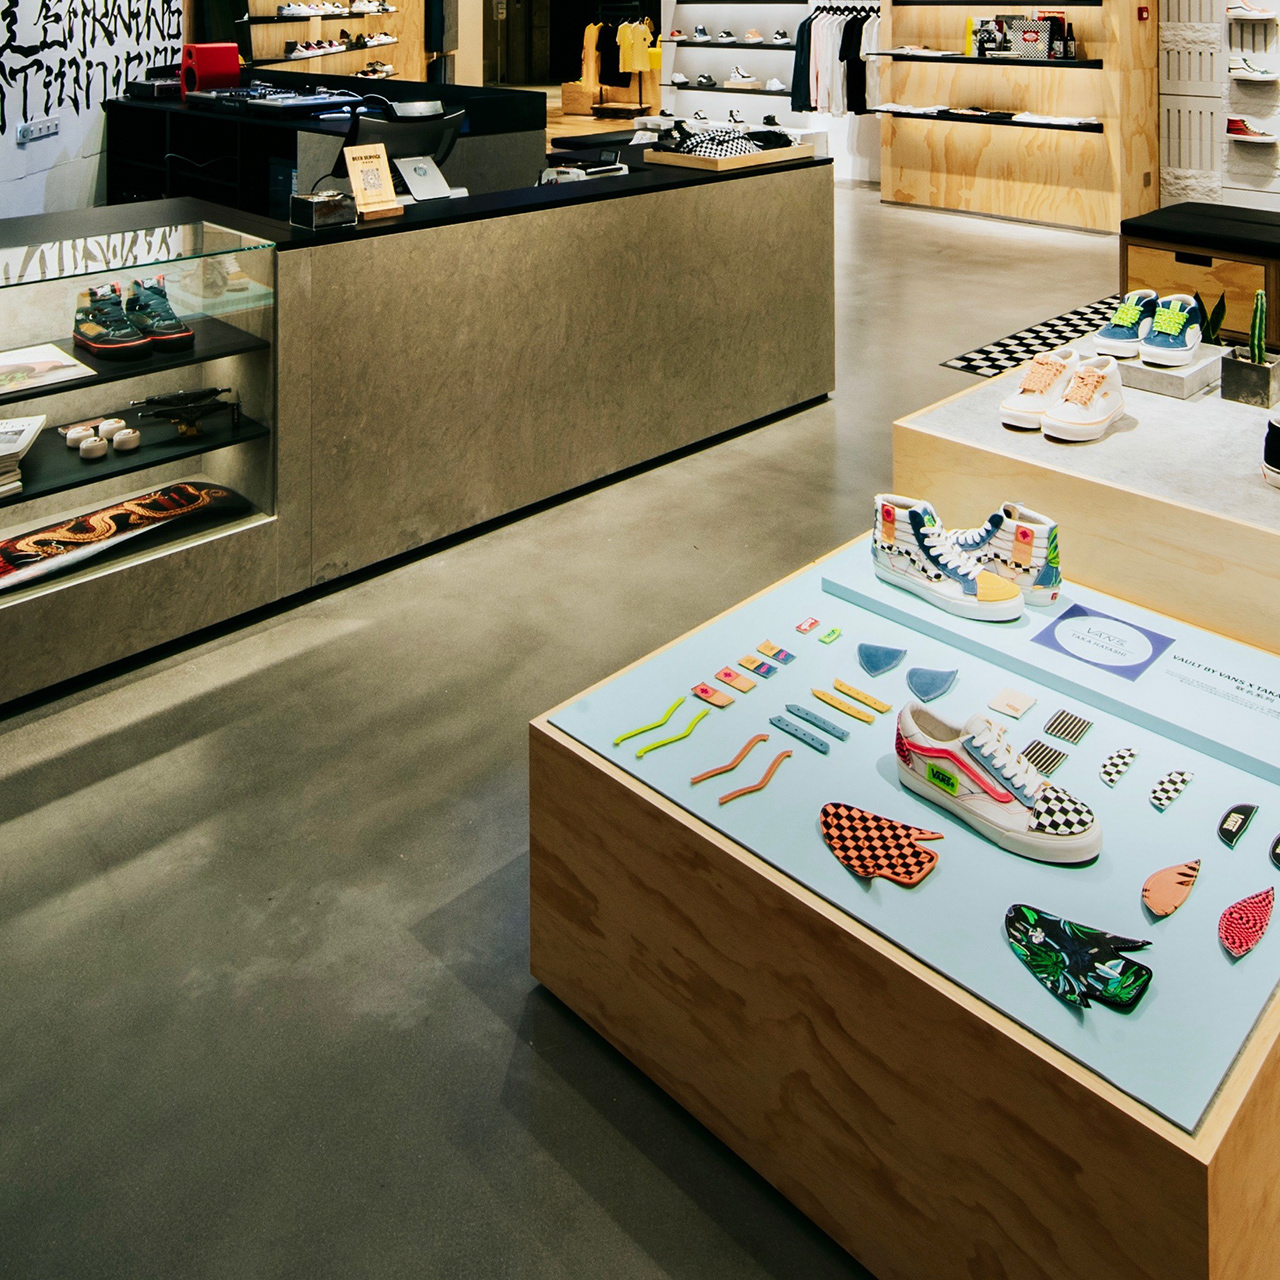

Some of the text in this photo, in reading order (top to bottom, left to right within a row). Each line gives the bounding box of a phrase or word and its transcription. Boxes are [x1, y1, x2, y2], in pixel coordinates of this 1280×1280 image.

[1071, 633, 1128, 658] TAKA HAYASHI
[1085, 627, 1128, 649] VANS
[1172, 654, 1202, 669] VAULT
[1204, 666, 1218, 674] BY
[1219, 671, 1246, 686] VANS
